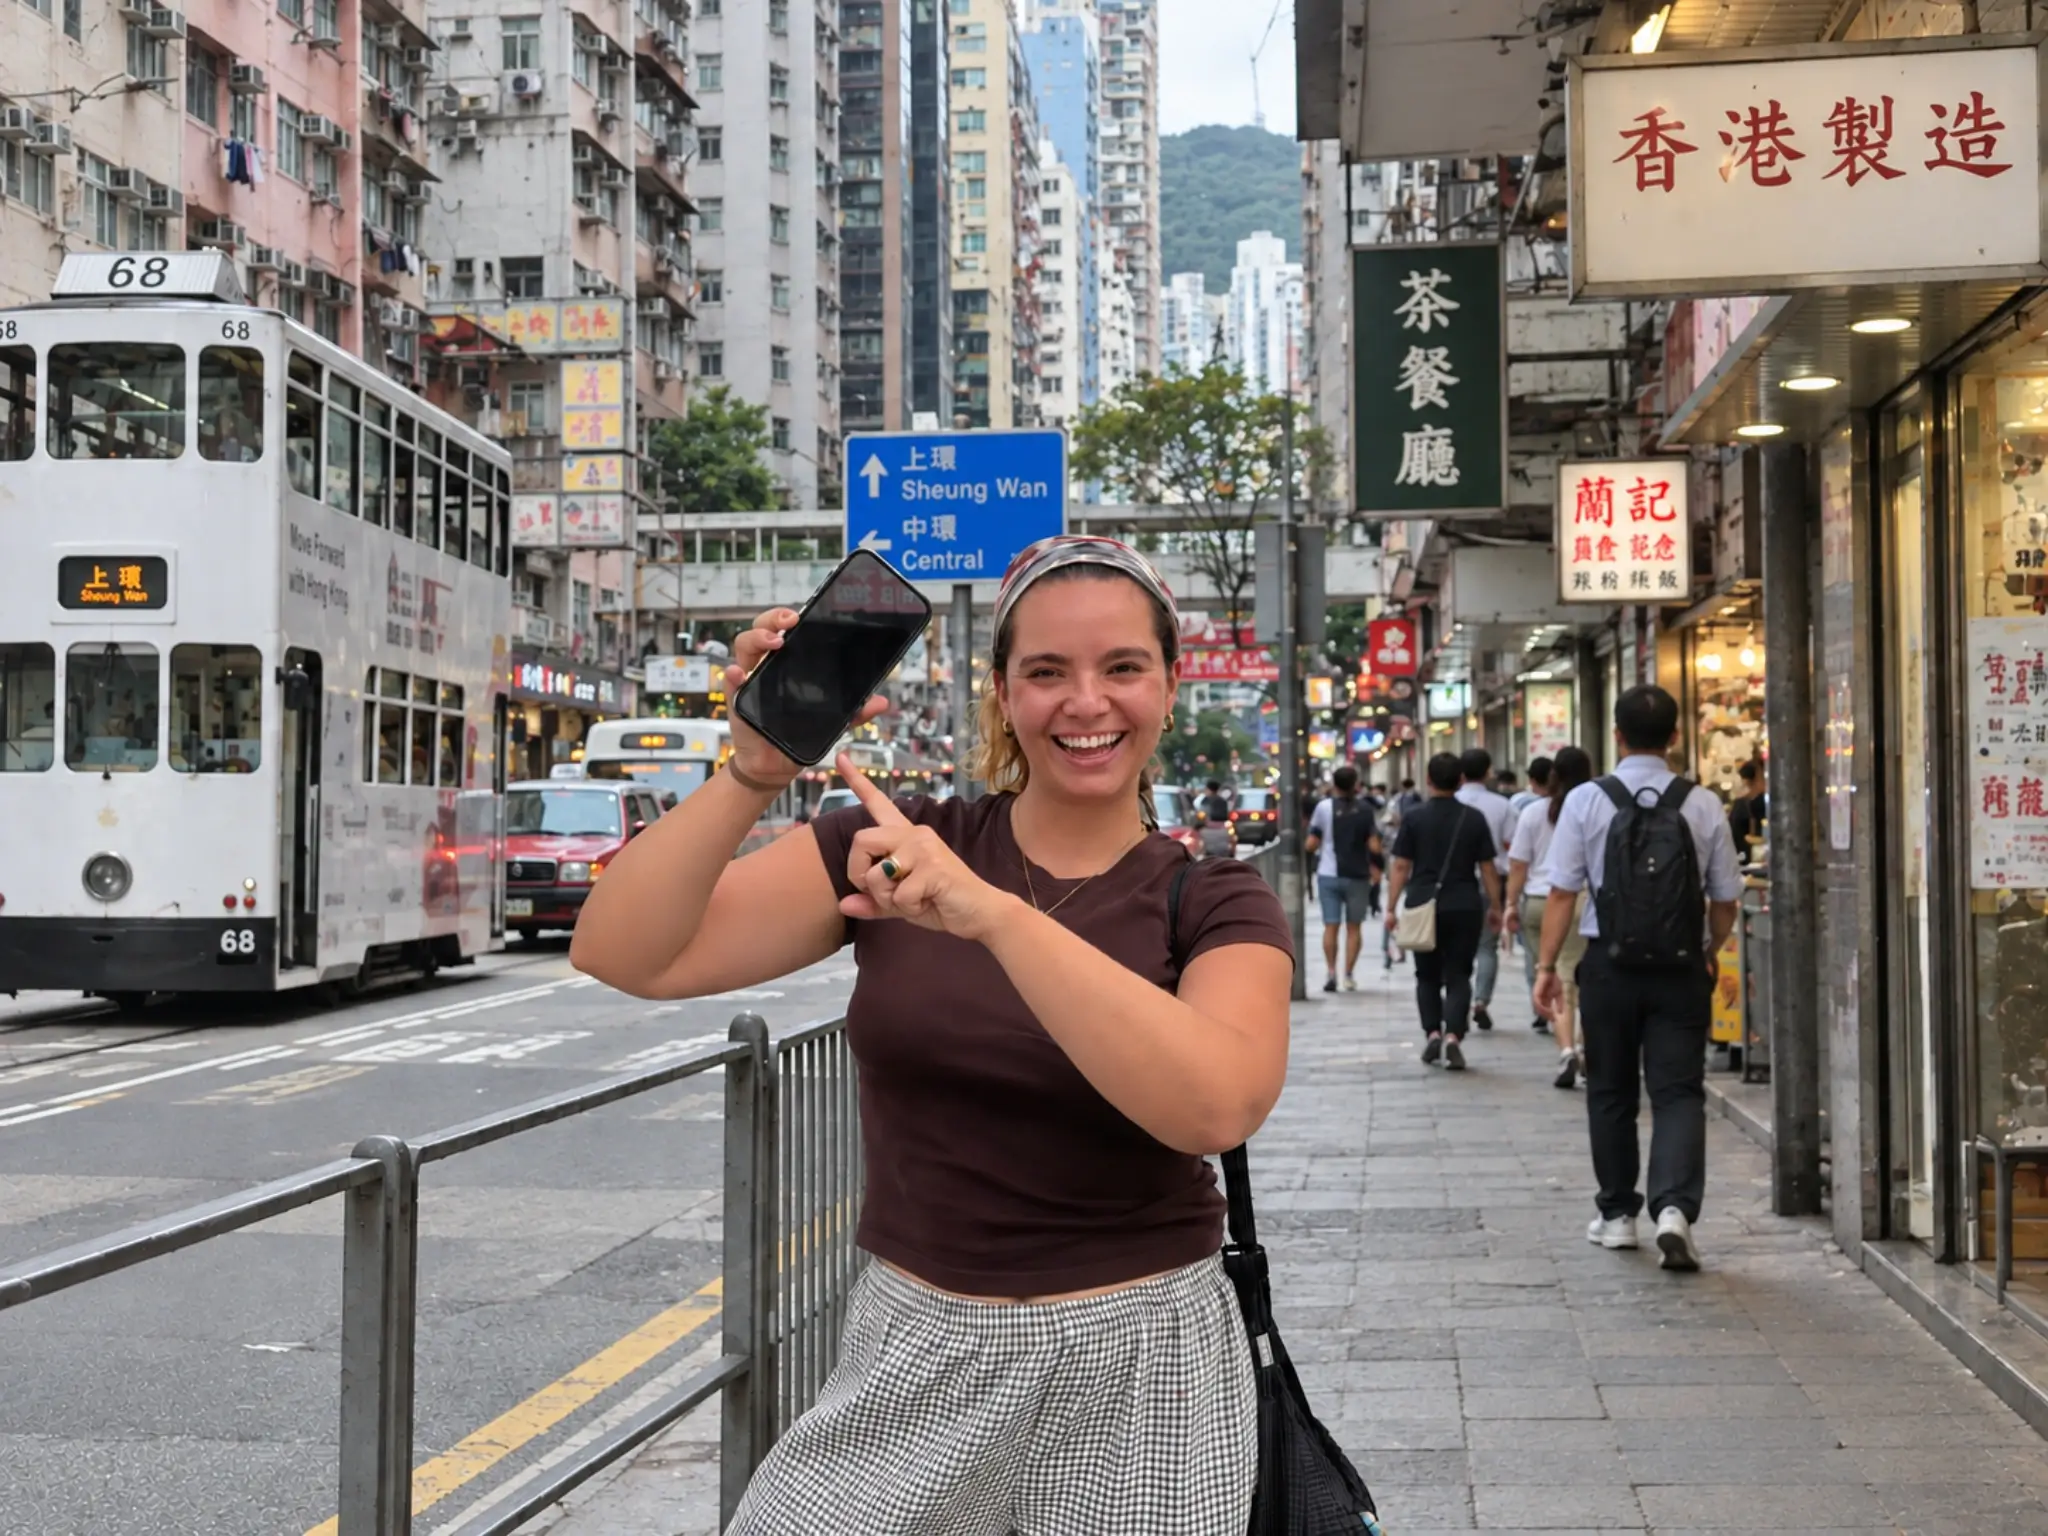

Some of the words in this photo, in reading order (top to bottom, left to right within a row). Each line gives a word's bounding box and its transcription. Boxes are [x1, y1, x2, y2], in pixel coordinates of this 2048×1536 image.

[1612, 91, 2013, 192] 香港製造
[108, 257, 169, 288] 68
[221, 321, 250, 340] 68
[1394, 268, 1460, 487] 茶餐廳
[901, 445, 957, 471] 上環
[901, 479, 988, 504] Sheung
[996, 478, 1048, 499] Wan
[1575, 476, 1677, 528] 蘭記
[902, 515, 957, 542] 中環
[290, 523, 312, 557] Move
[314, 532, 347, 569] Forward
[901, 549, 984, 571] Central
[289, 566, 306, 595] with
[307, 571, 327, 610] Hong
[329, 579, 349, 615] Kong
[220, 930, 256, 954] 68
